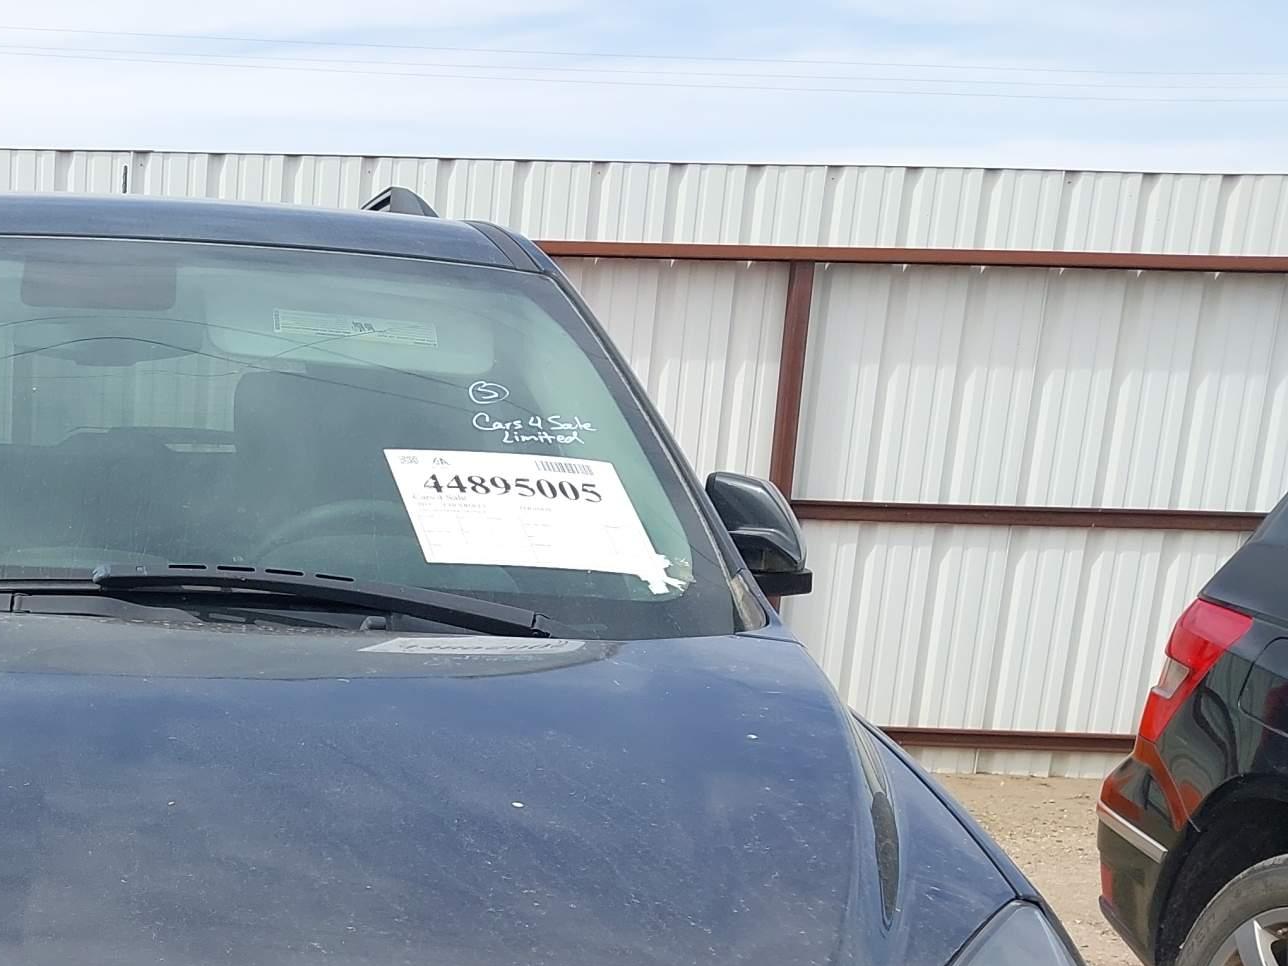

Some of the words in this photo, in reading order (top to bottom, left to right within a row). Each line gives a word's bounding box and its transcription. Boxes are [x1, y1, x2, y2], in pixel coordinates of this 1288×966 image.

[472, 411, 523, 431] Cars
[528, 415, 544, 430] 4
[546, 415, 598, 432] Sale
[502, 430, 585, 445] Limited
[423, 473, 603, 503] 44895005
